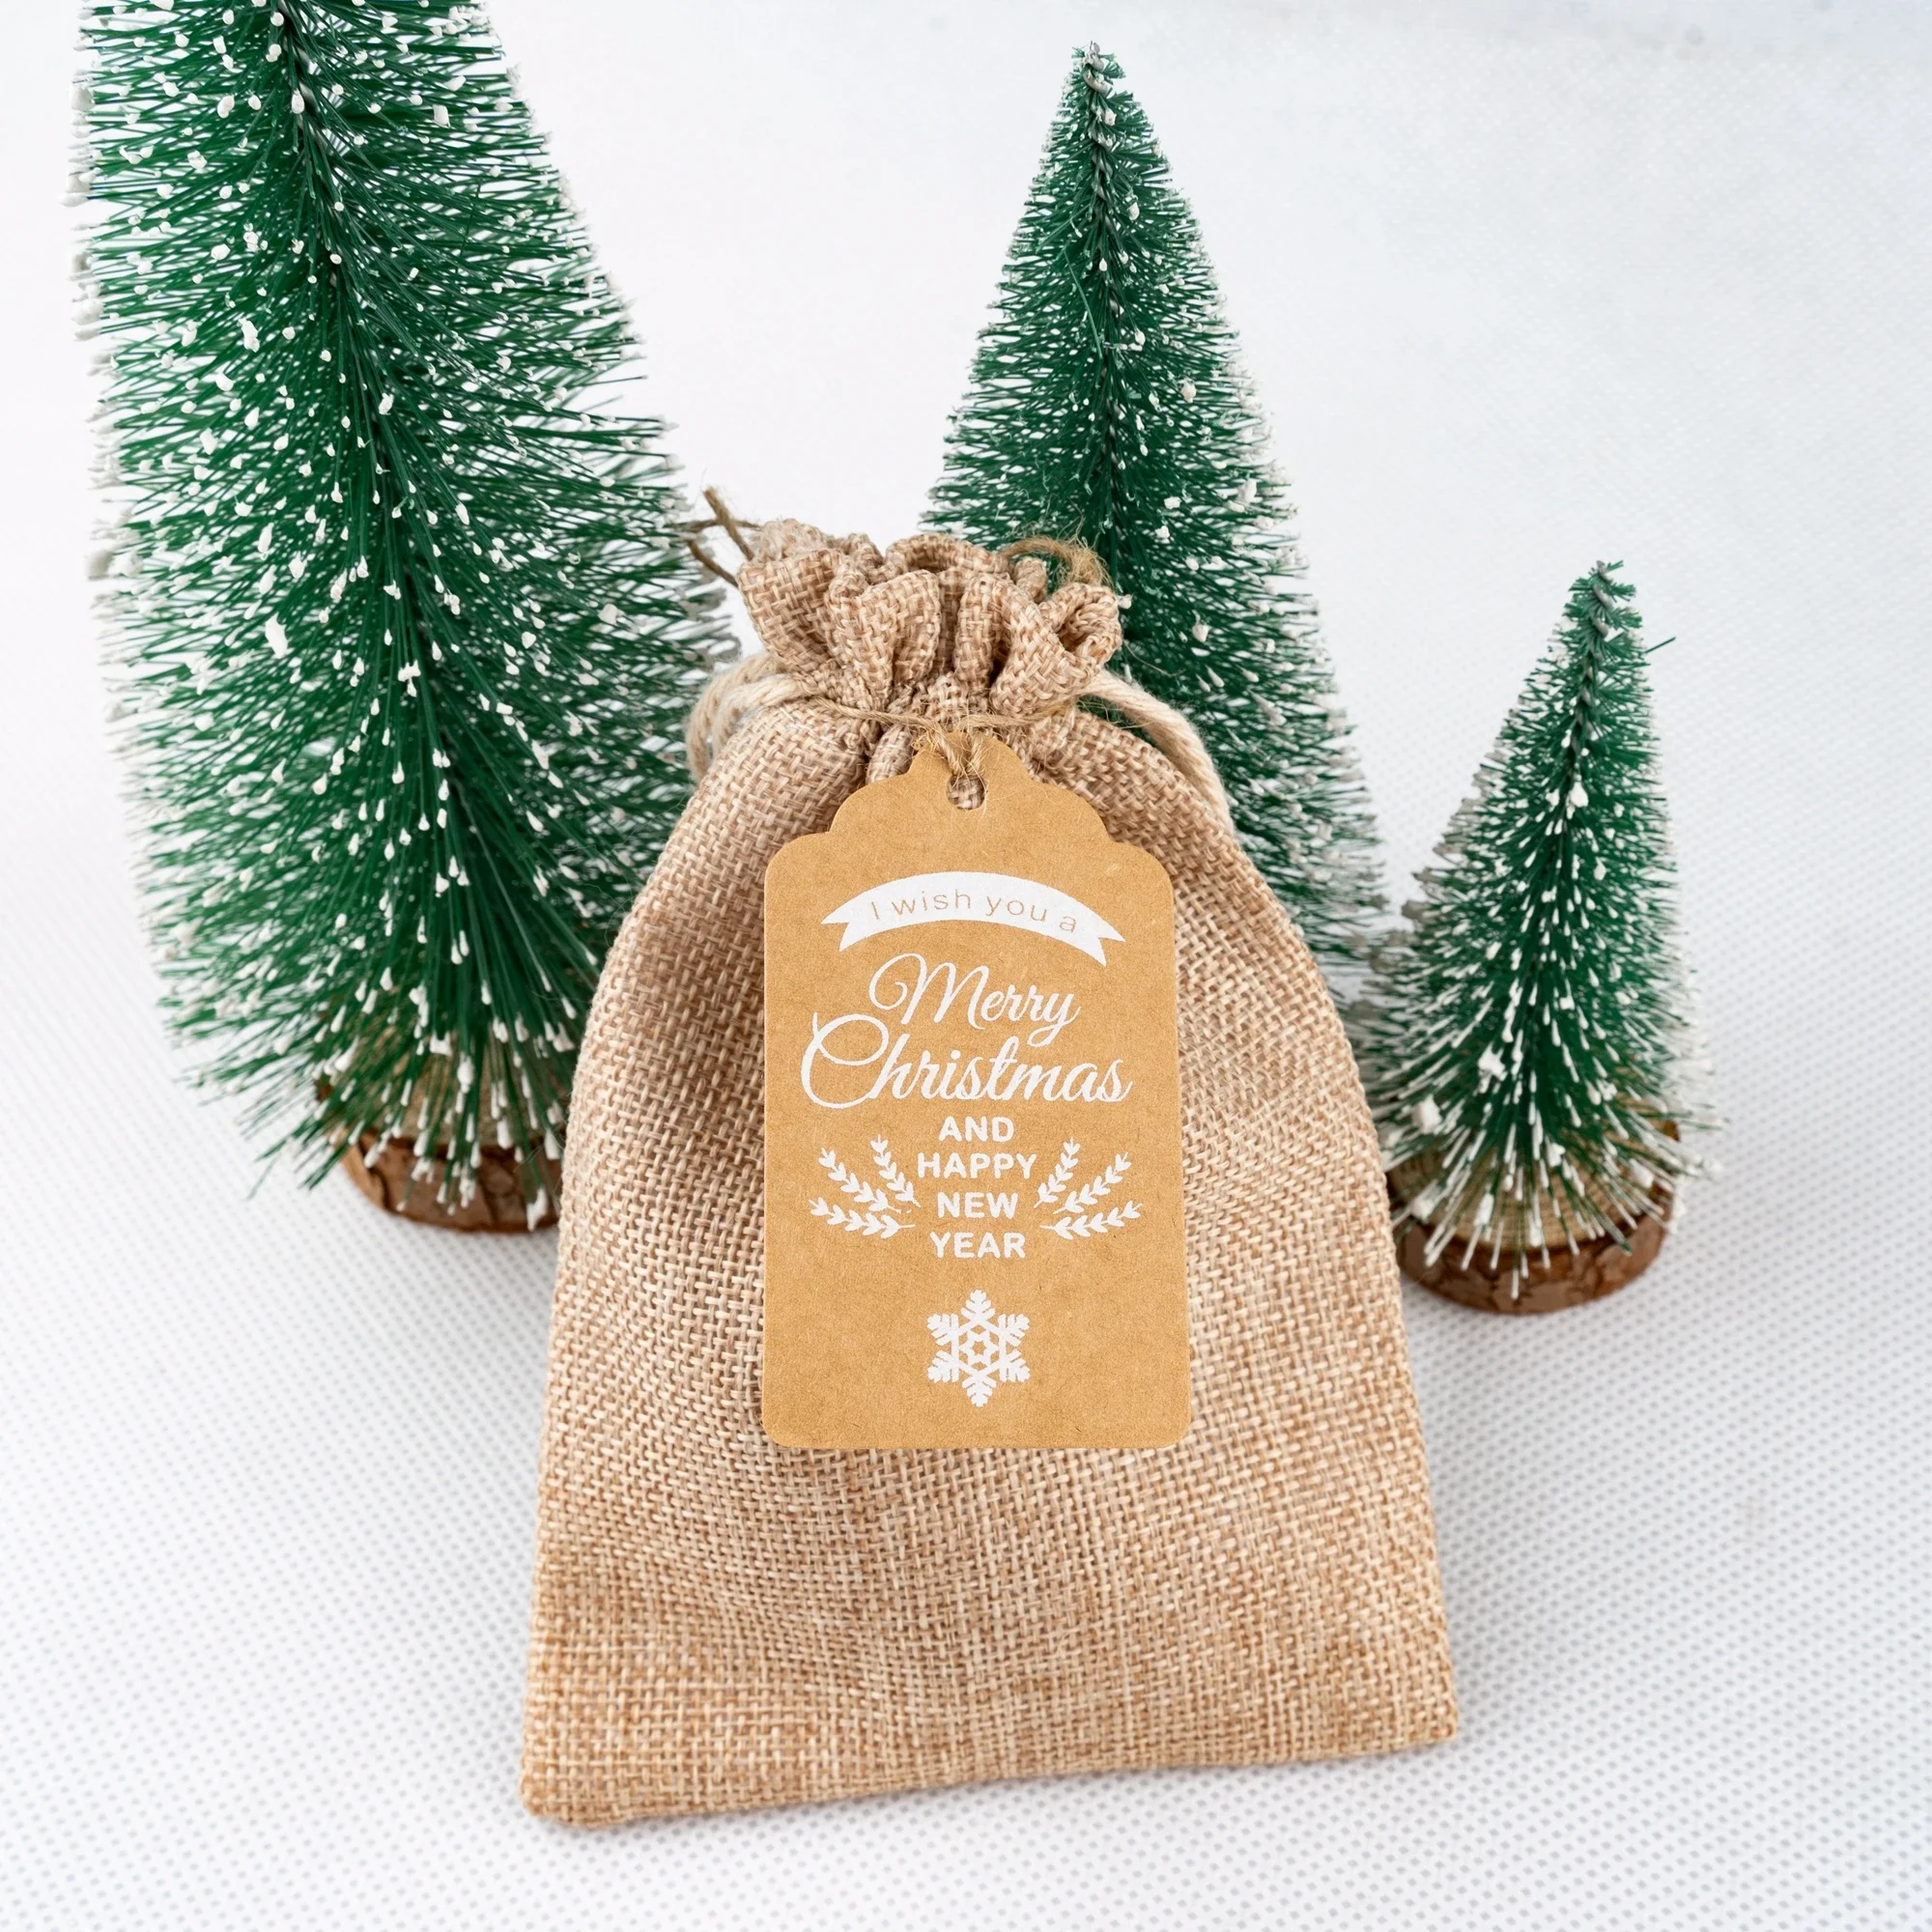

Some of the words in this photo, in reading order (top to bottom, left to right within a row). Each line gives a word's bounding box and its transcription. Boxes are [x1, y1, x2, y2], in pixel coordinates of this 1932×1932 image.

[871, 900, 880, 920] I
[891, 888, 972, 917] wish
[985, 895, 1049, 923] you
[1058, 915, 1078, 933] a
[868, 952, 1081, 1047] Merry
[801, 1011, 1133, 1109] Christmas
[938, 1116, 1014, 1142] AND
[917, 1152, 1037, 1179] HAPPY
[937, 1191, 1019, 1218] NEW
[929, 1232, 1026, 1259] YEAR
